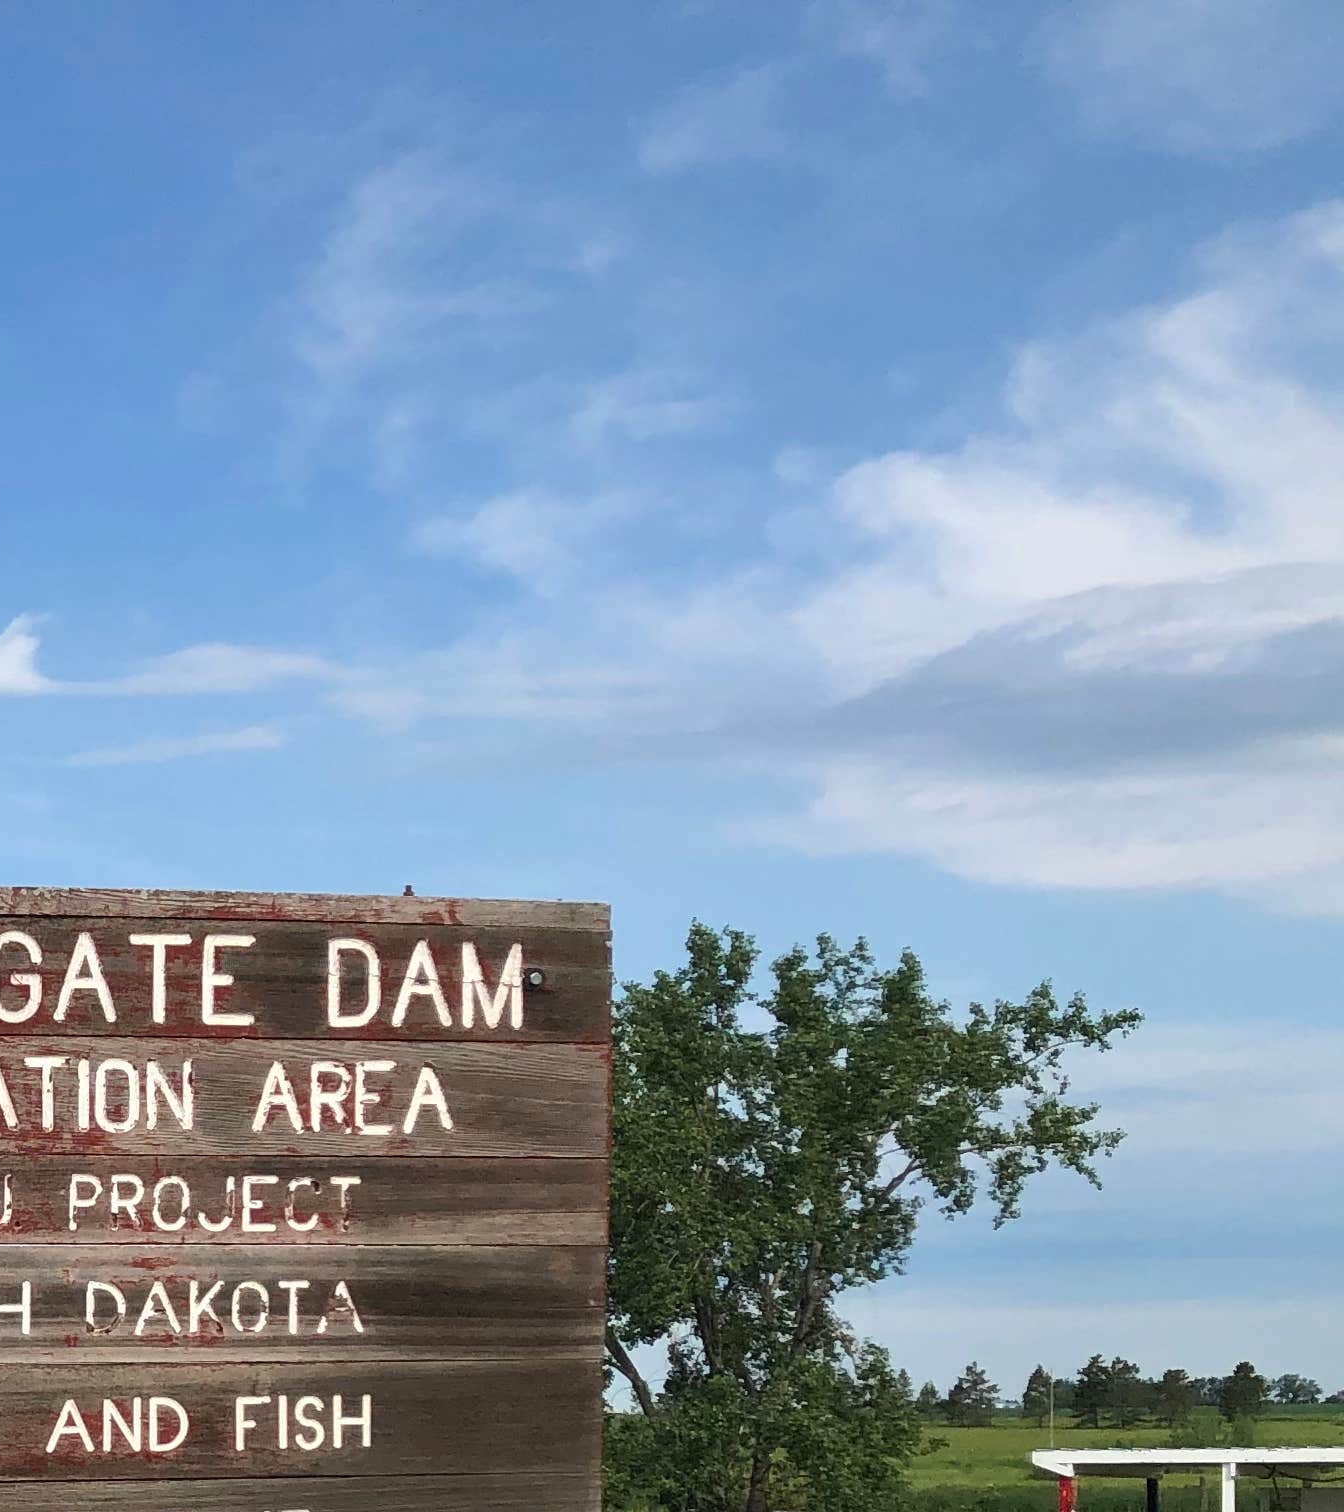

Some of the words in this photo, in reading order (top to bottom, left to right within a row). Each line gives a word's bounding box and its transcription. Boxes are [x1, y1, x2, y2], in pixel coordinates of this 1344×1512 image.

[328, 939, 523, 1028] DAM
[252, 1061, 452, 1135] AREA
[69, 1174, 361, 1232] PROJECT
[86, 1280, 363, 1335] DAKOTA
[46, 1396, 190, 1454] AND
[234, 1394, 372, 1452] FISH
